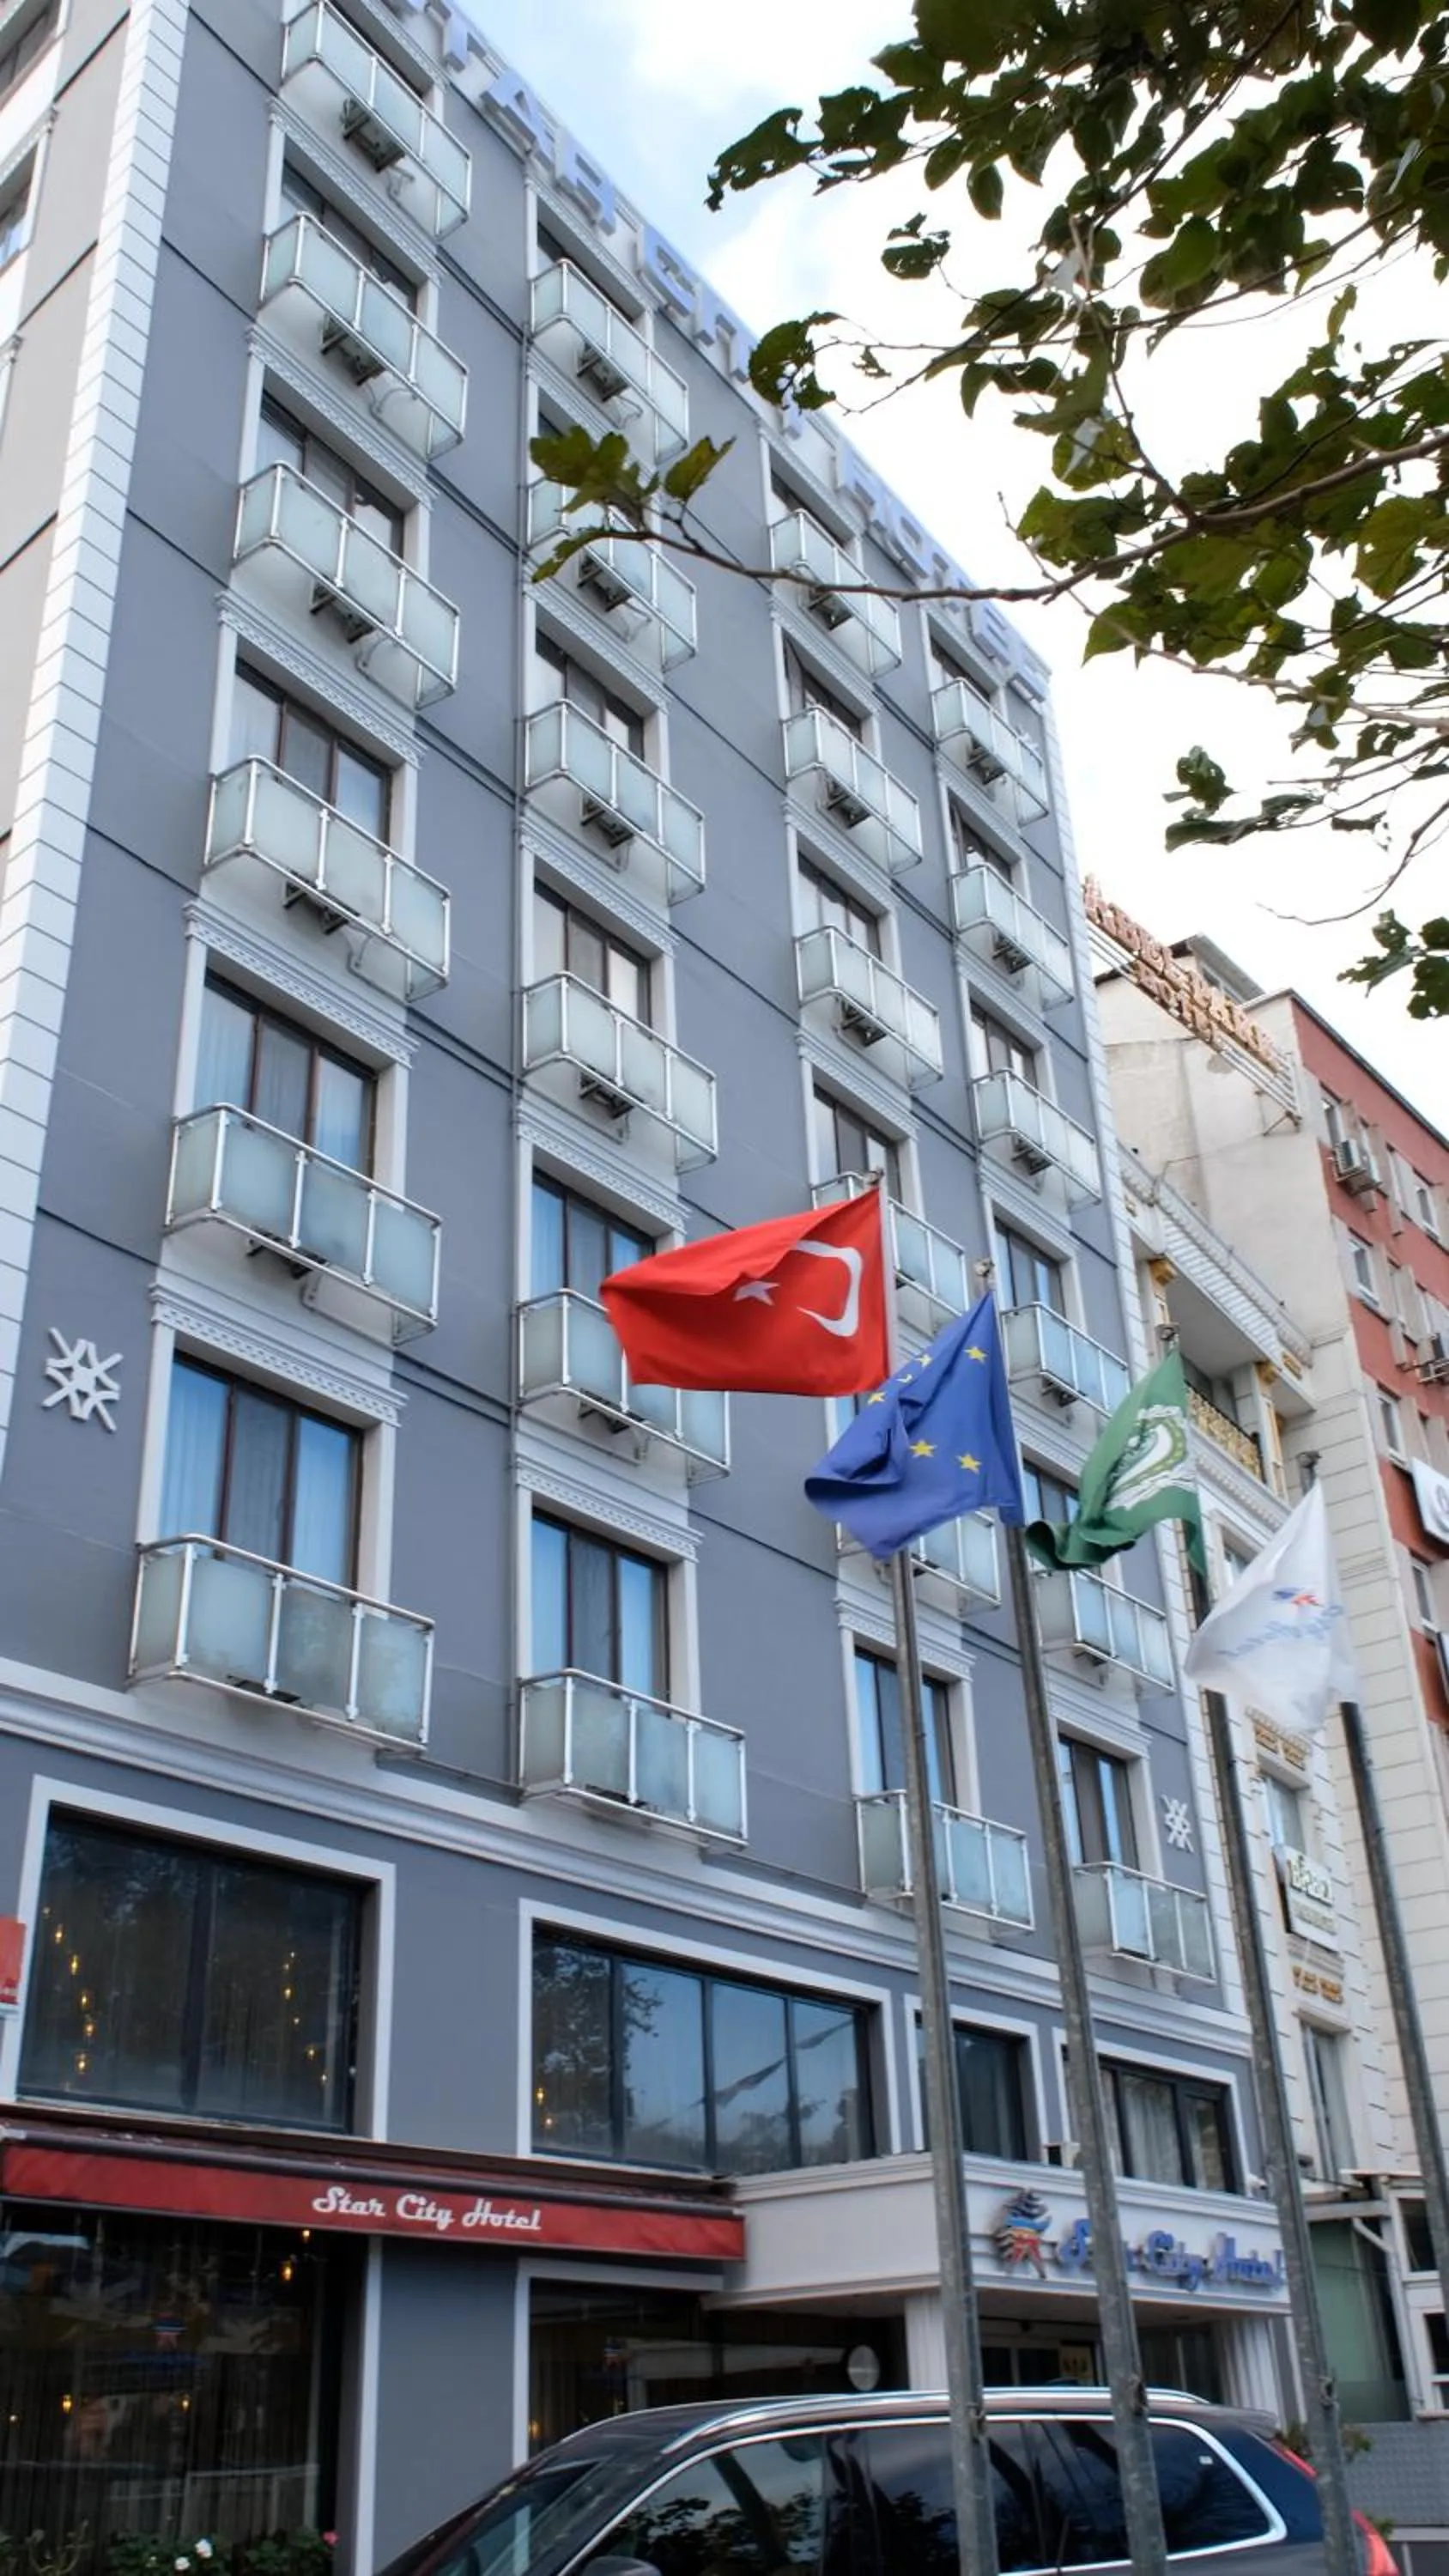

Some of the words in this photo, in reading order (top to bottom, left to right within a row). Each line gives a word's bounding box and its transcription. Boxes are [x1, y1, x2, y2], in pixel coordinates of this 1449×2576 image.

[379, 0, 619, 237] TAR
[833, 432, 1047, 704] HOTEL
[312, 2184, 387, 2217] Star
[396, 2193, 455, 2231] City
[462, 2197, 542, 2231] Hotel
[1145, 2229, 1206, 2292] City
